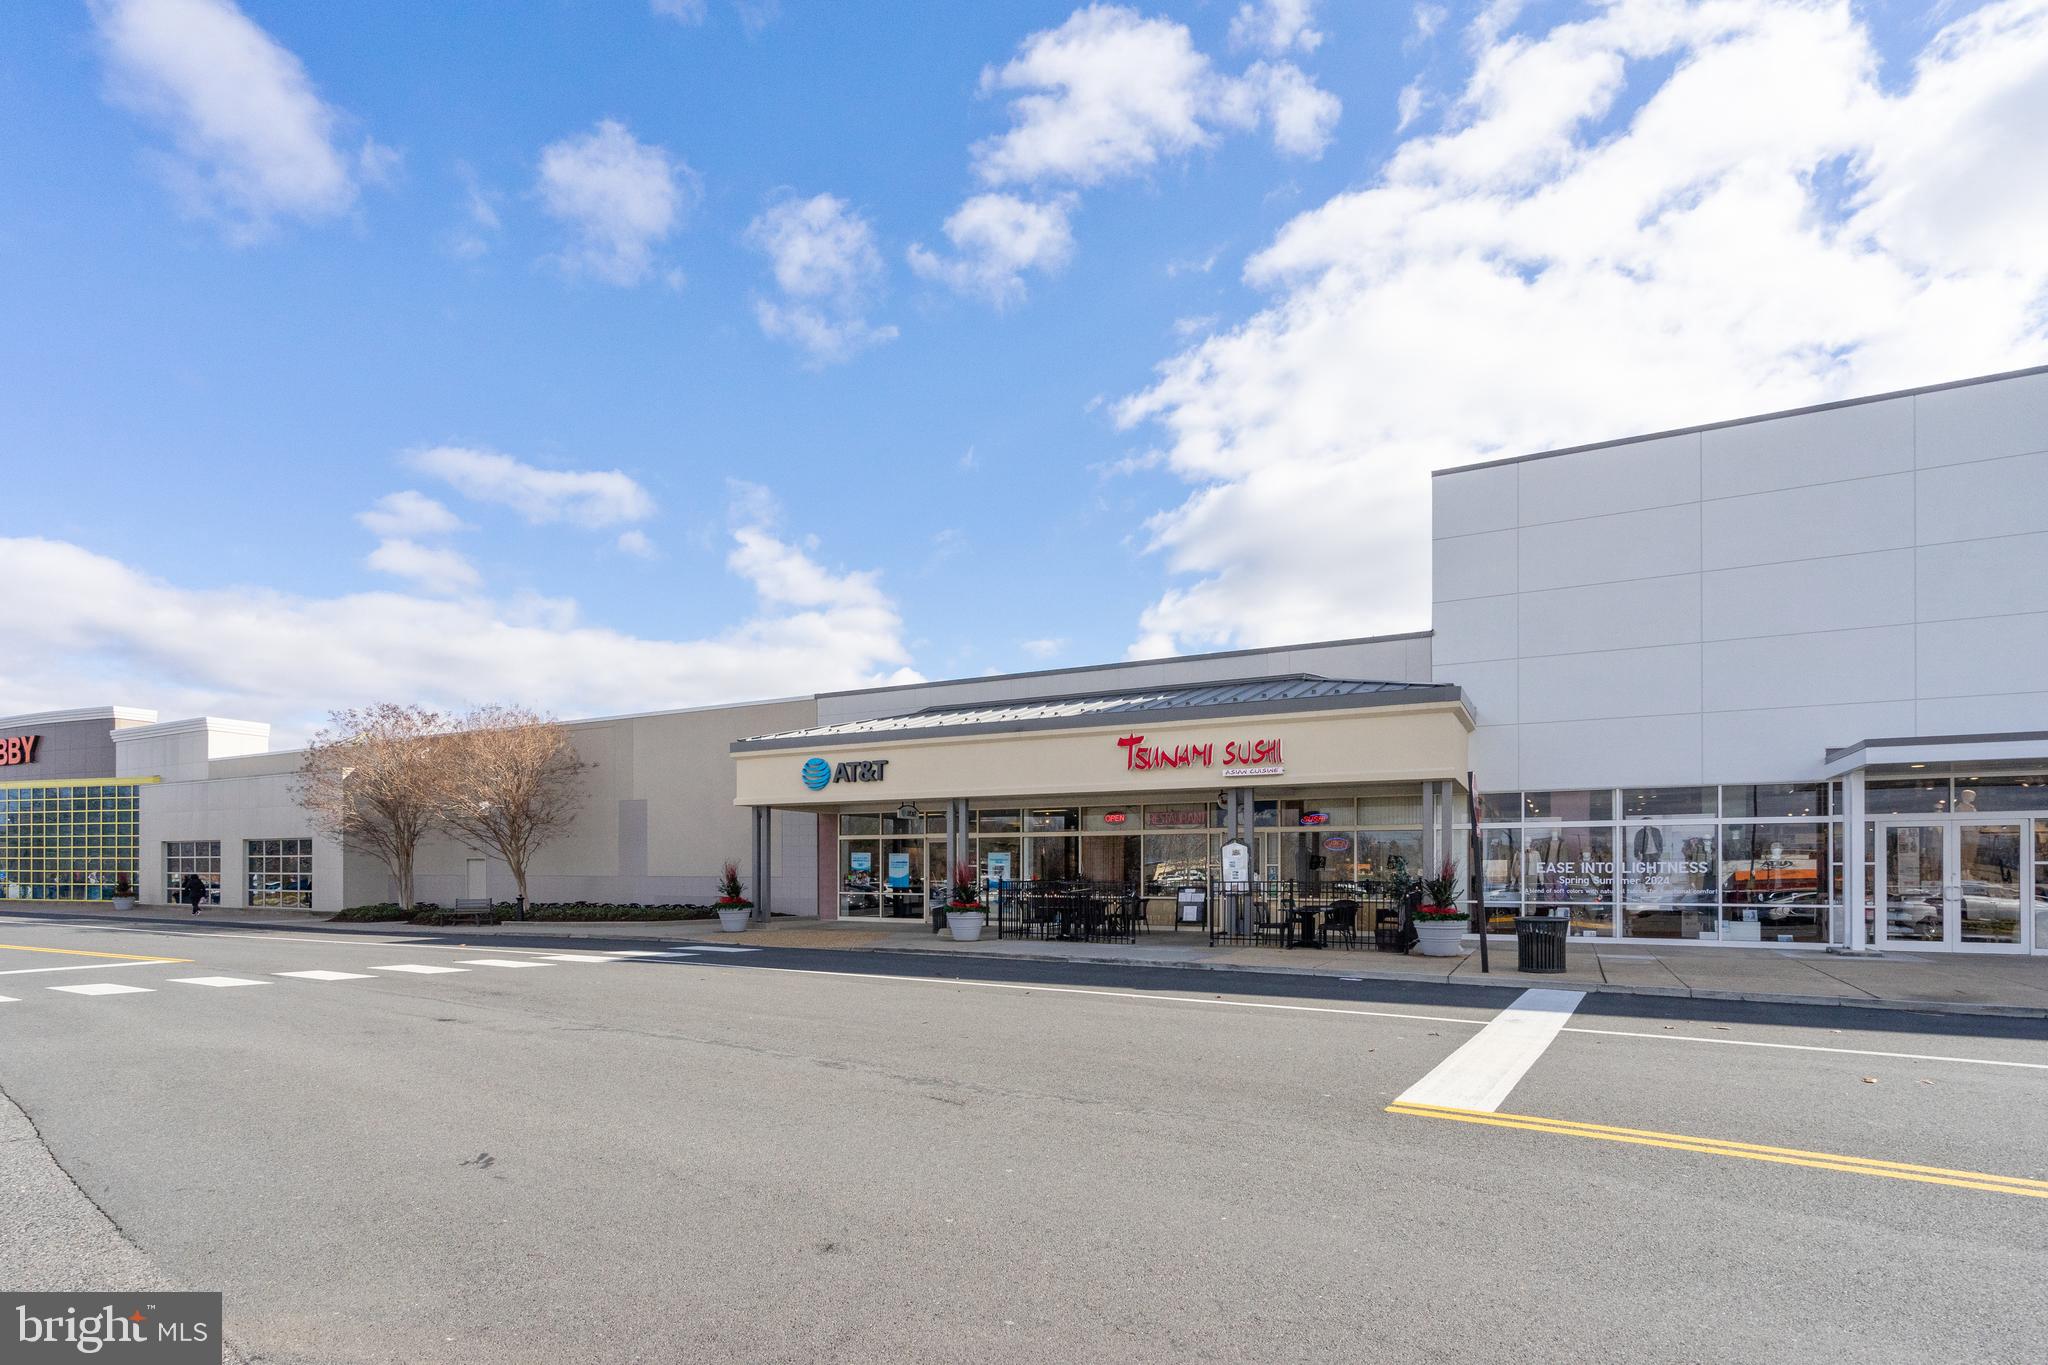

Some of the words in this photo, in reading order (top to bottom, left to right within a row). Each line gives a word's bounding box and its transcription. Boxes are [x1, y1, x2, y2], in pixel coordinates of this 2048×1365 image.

[1117, 733, 1214, 770] TSUNAMI
[1223, 738, 1283, 765] SUSHI
[833, 759, 889, 783] AT&T
[1104, 814, 1126, 823] OPEN
[1536, 862, 1575, 874] EASE
[1581, 862, 1615, 874] INTO
[1621, 861, 1709, 874] LIGHTNESS
[1559, 876, 1590, 887] Spring
[1644, 876, 1670, 885] 2024
